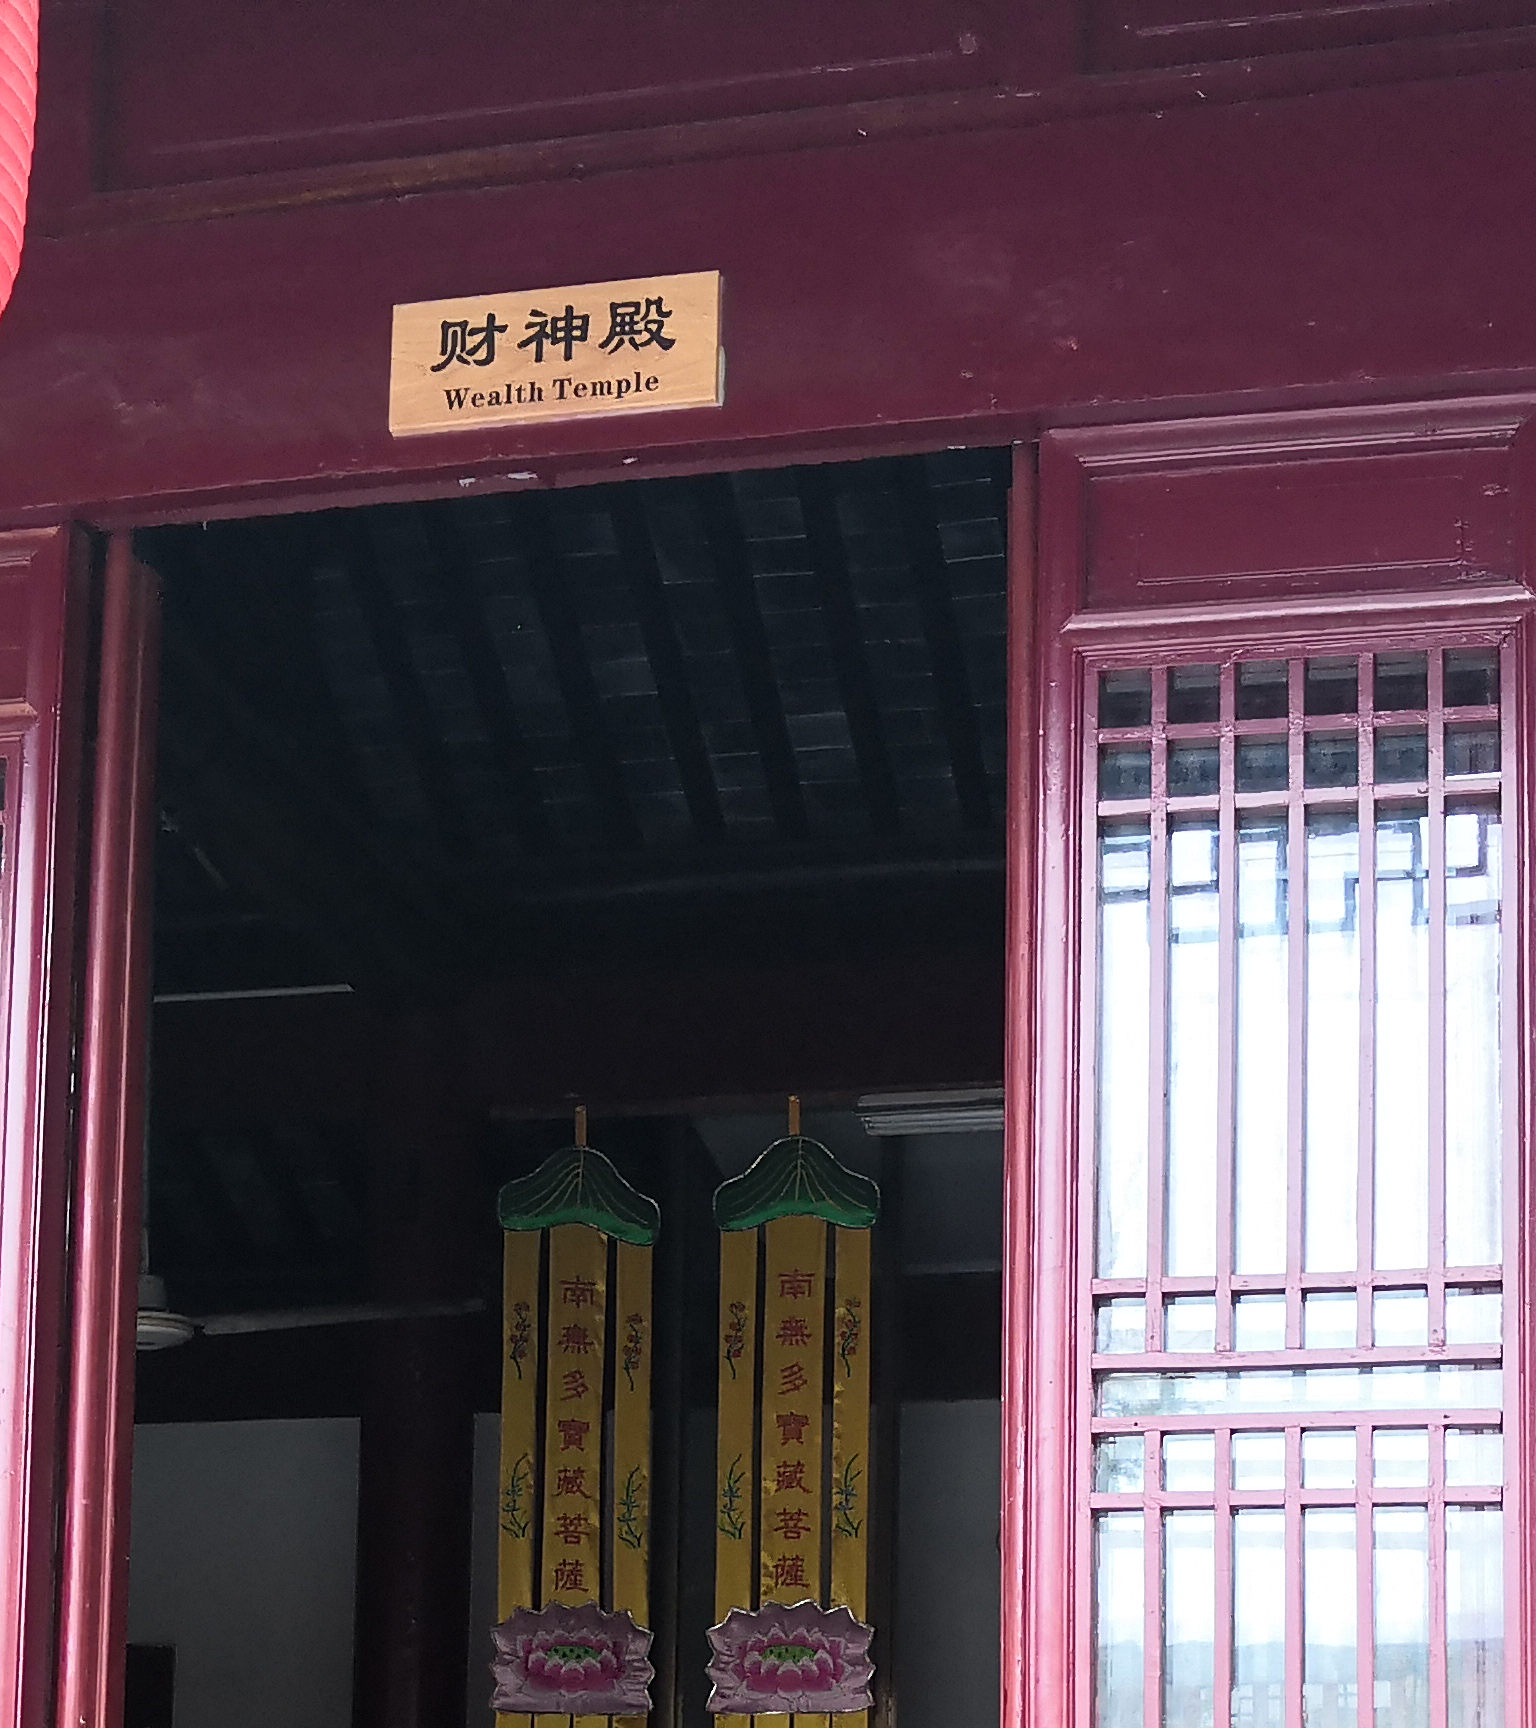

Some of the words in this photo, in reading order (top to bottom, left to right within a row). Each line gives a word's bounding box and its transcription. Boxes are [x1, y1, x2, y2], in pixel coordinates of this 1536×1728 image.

[430, 296, 676, 373] 财神殿
[444, 381, 544, 410] Wealth
[552, 373, 660, 400] Temple
